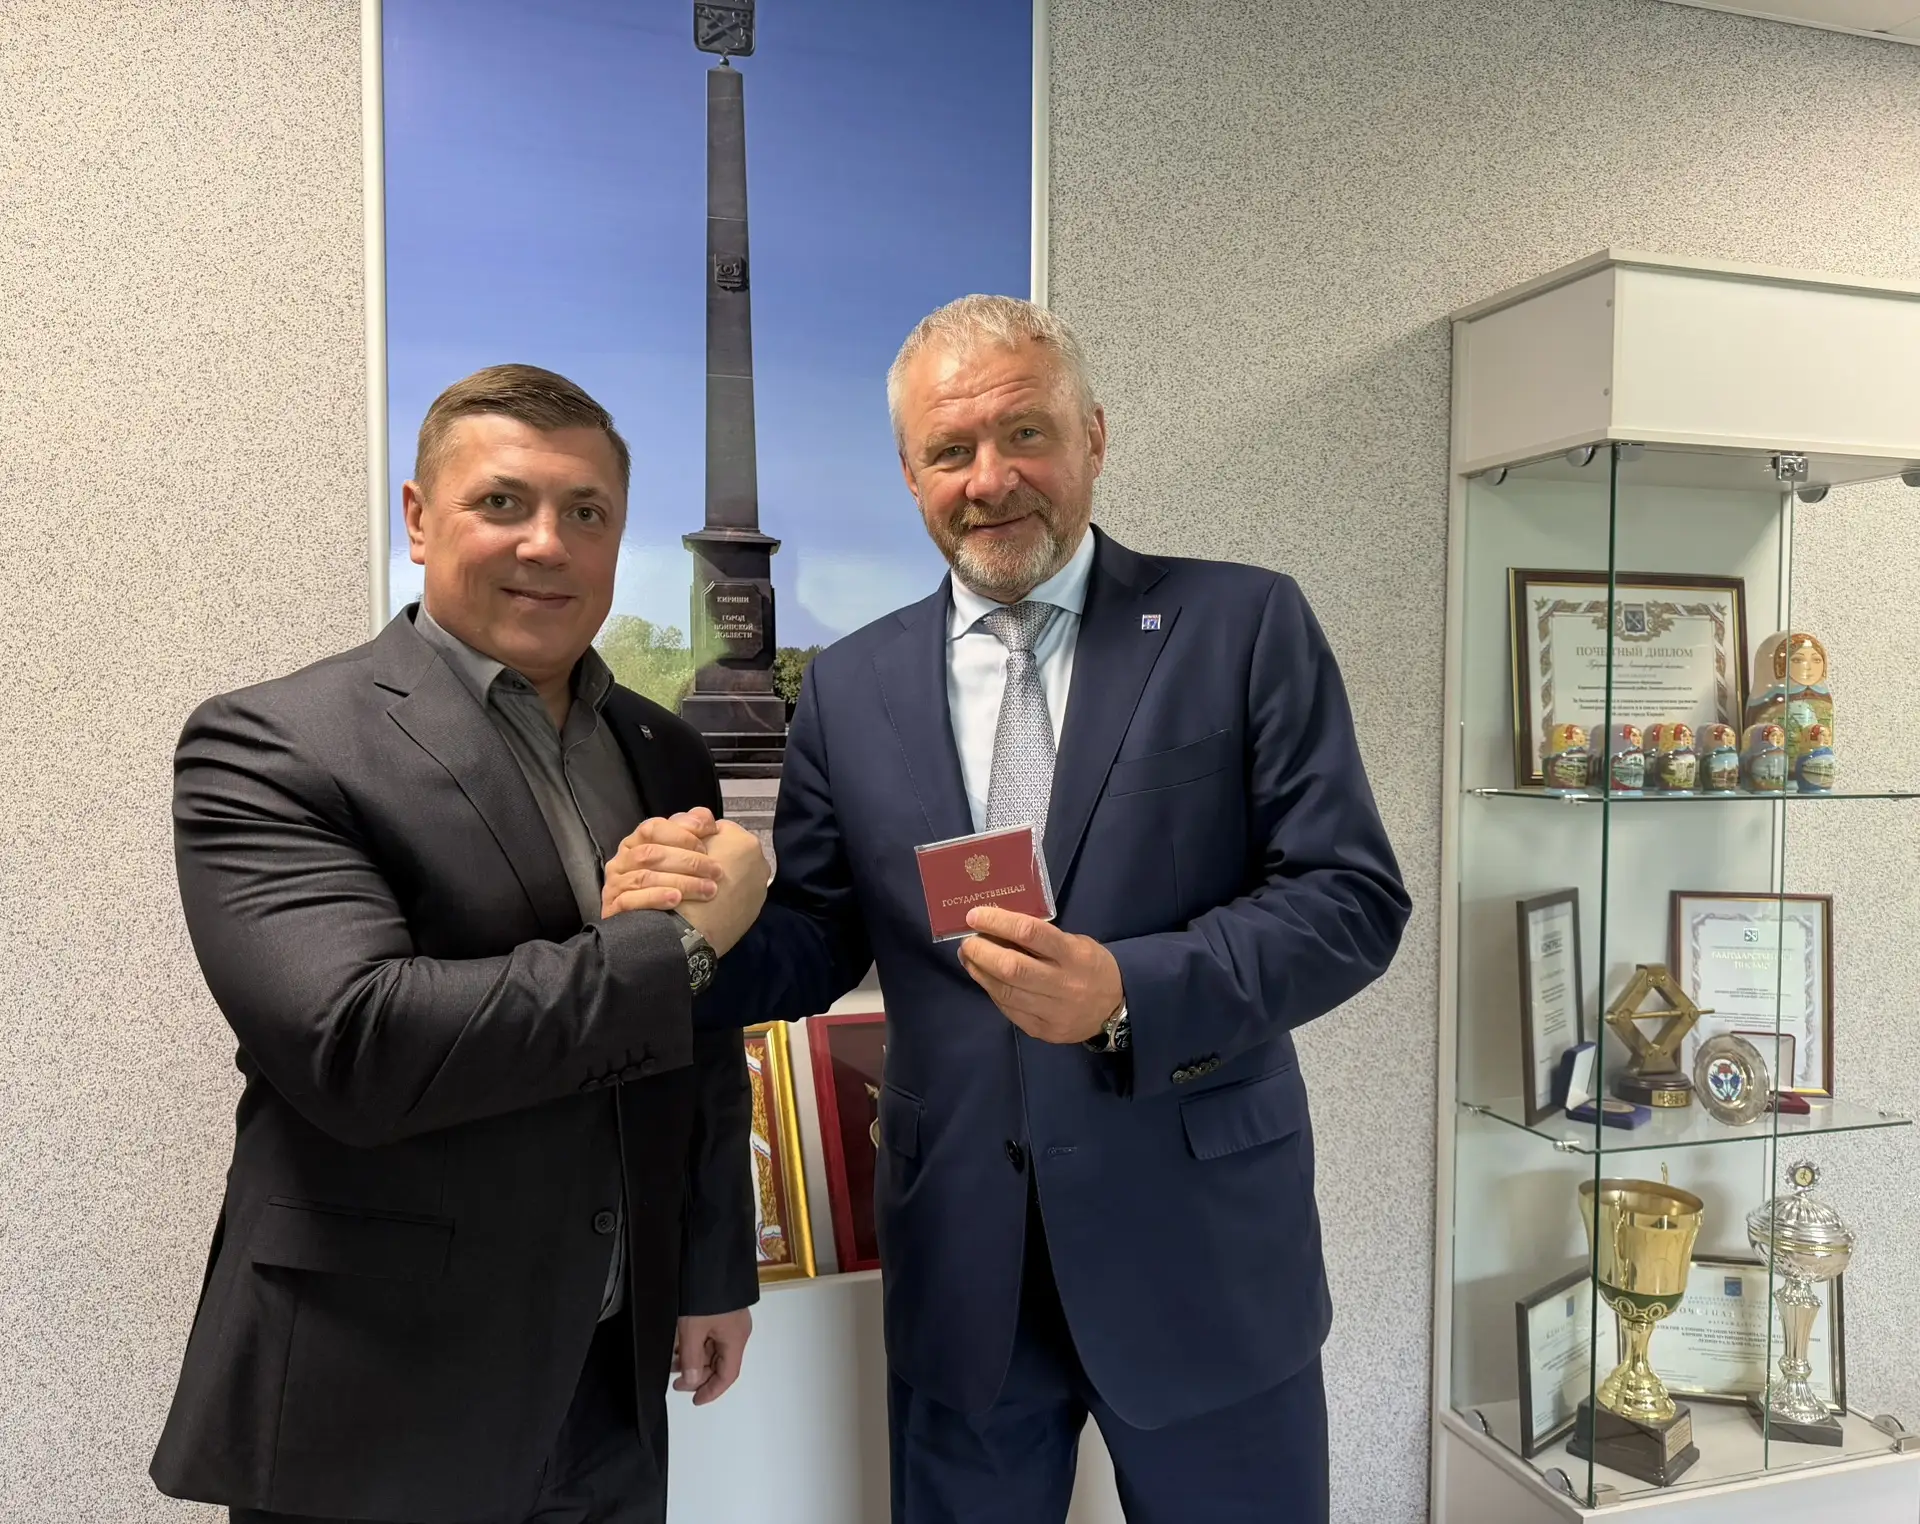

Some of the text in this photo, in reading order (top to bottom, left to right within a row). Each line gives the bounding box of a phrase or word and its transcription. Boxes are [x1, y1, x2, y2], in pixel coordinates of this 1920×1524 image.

[722, 614, 746, 622] ГОРОД
[714, 622, 753, 631] ВОИНСКОЙ
[714, 631, 752, 639] ДОБЛЕСТИ
[1645, 647, 1693, 658] ДИПЛОМ
[941, 884, 1026, 907] ГОСУДАРСТВЕННАЯ
